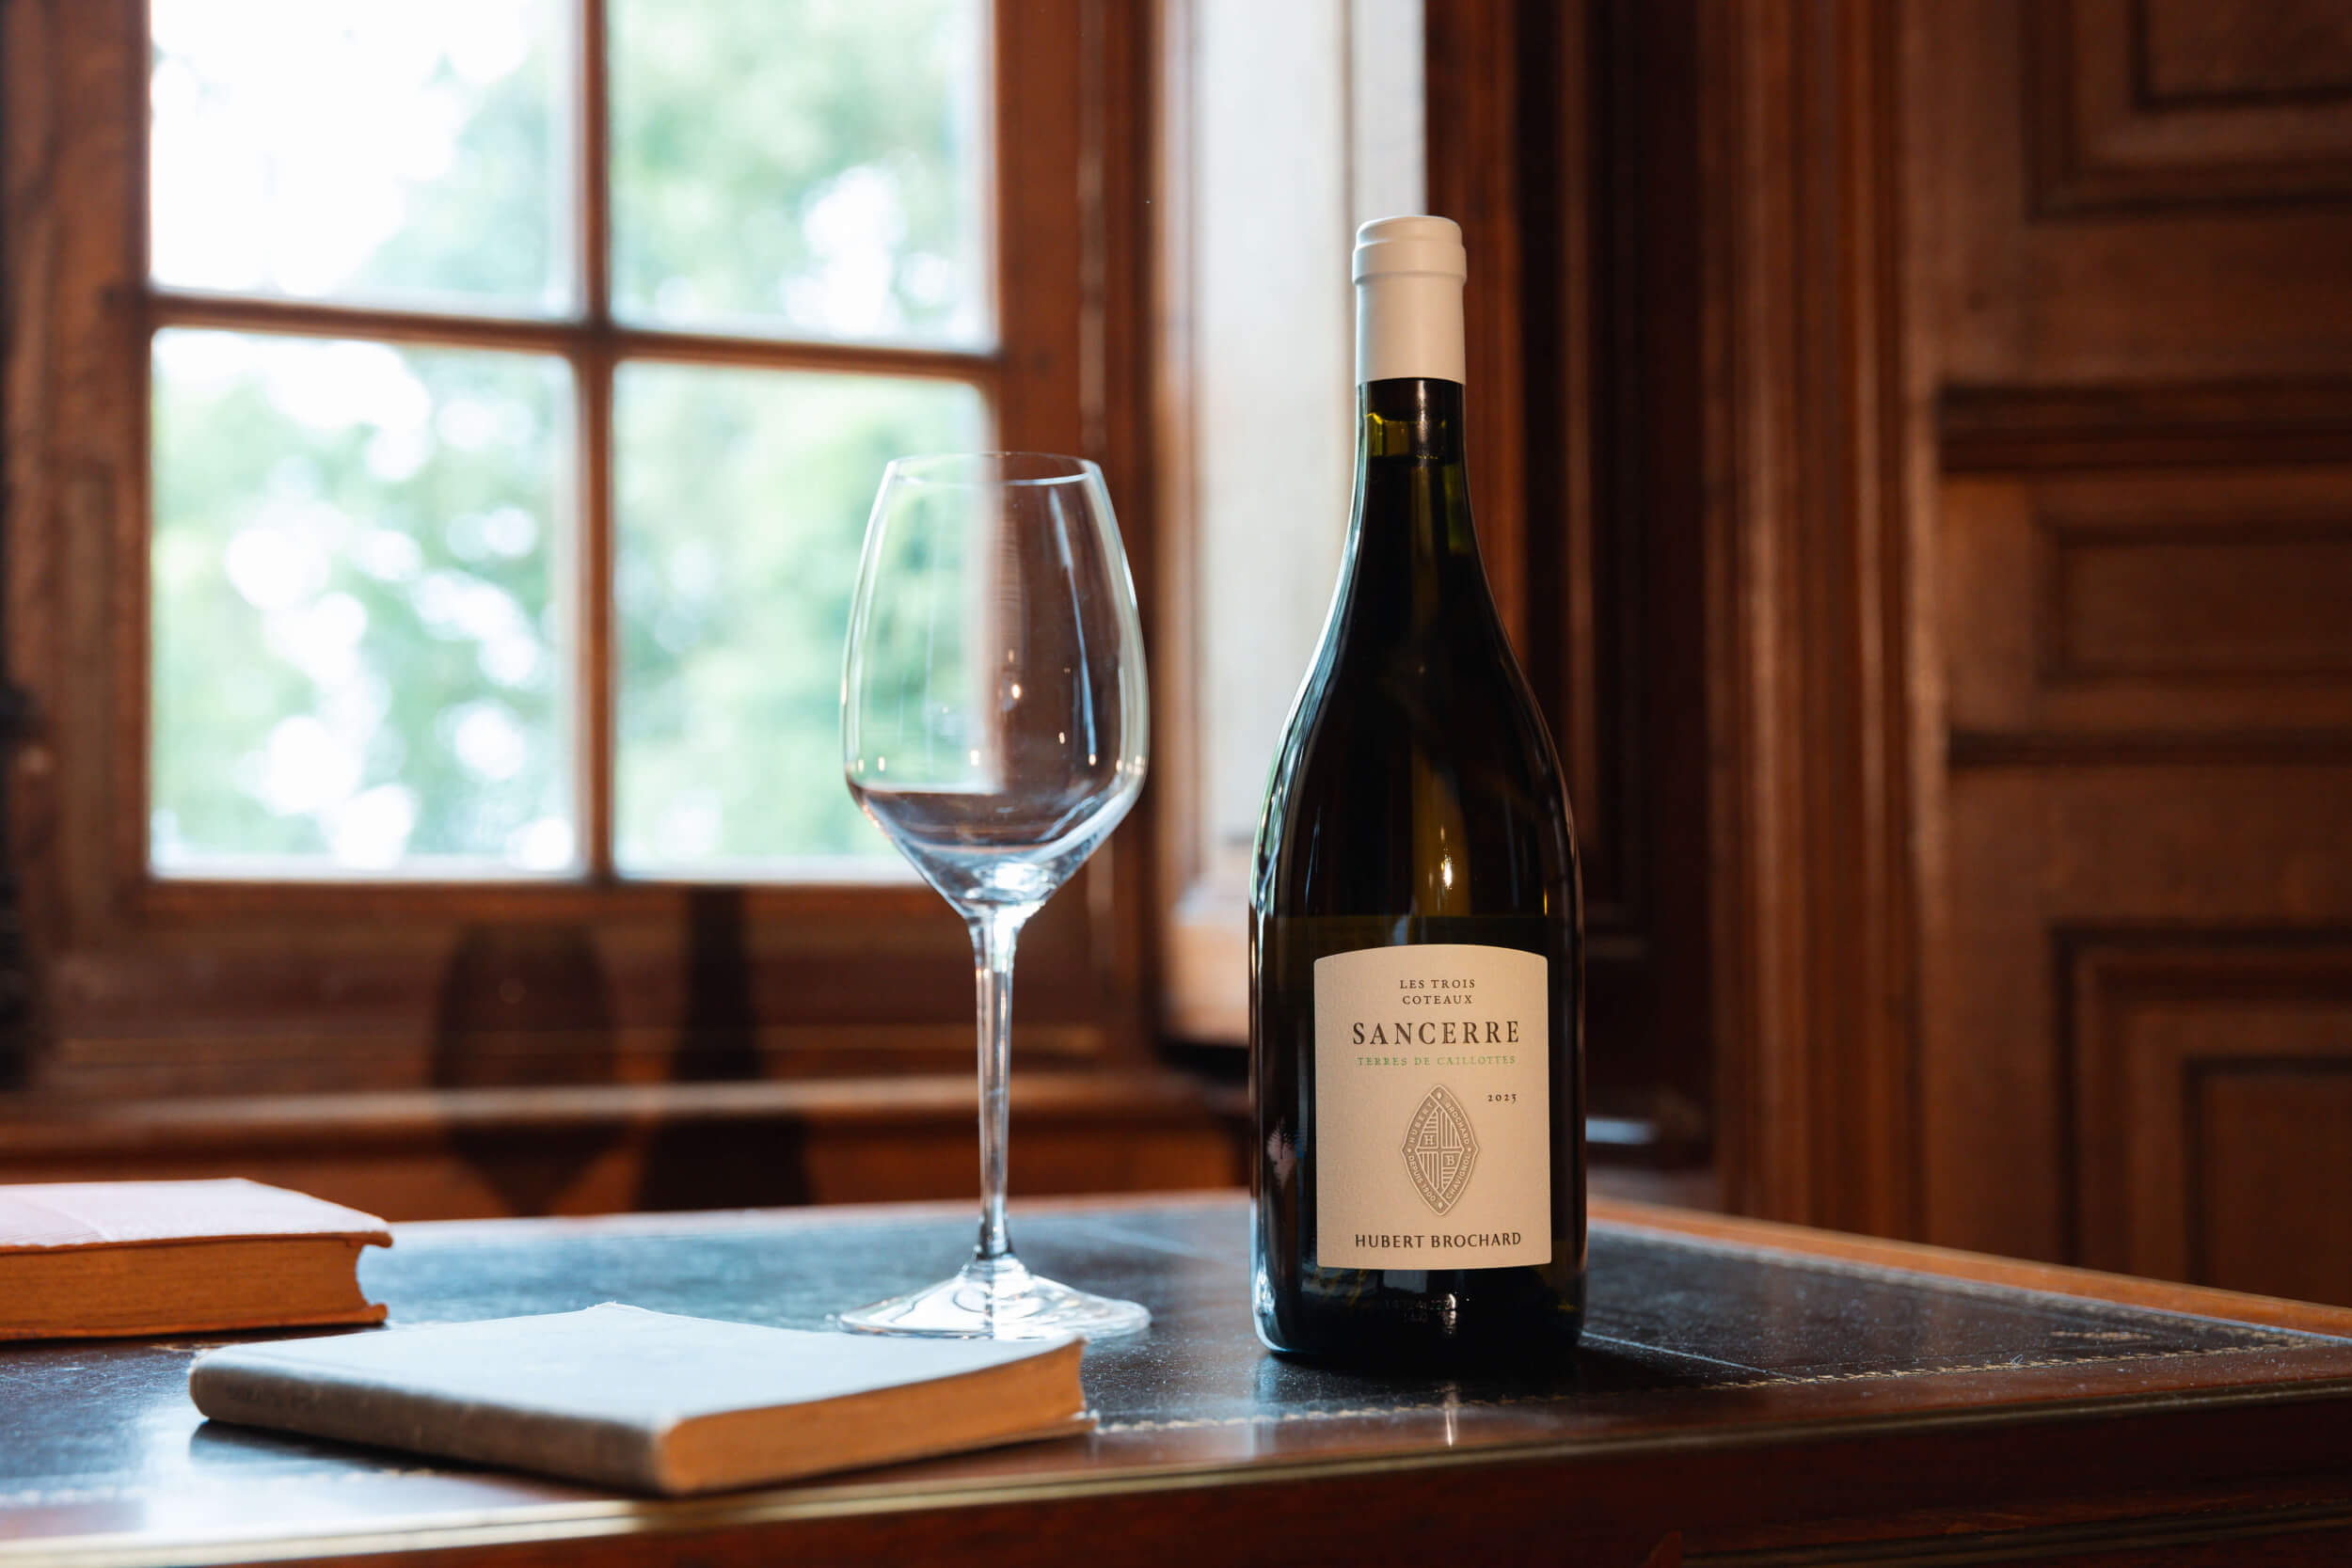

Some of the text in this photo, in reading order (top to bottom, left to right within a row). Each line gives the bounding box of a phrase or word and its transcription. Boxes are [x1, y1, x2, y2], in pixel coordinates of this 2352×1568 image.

[1400, 978, 1475, 989] LES TROIS
[1402, 995, 1473, 1005] COTEAUX
[1353, 1021, 1519, 1045] SANCERRE
[1357, 1054, 1517, 1066] TERRES DE CAILLOTTES
[1409, 1101, 1470, 1145] HUBERT BROCHARD
[1423, 1134, 1435, 1146] H
[1445, 1154, 1455, 1166] B
[1355, 1232, 1521, 1248] HUBERT BROCHARD
